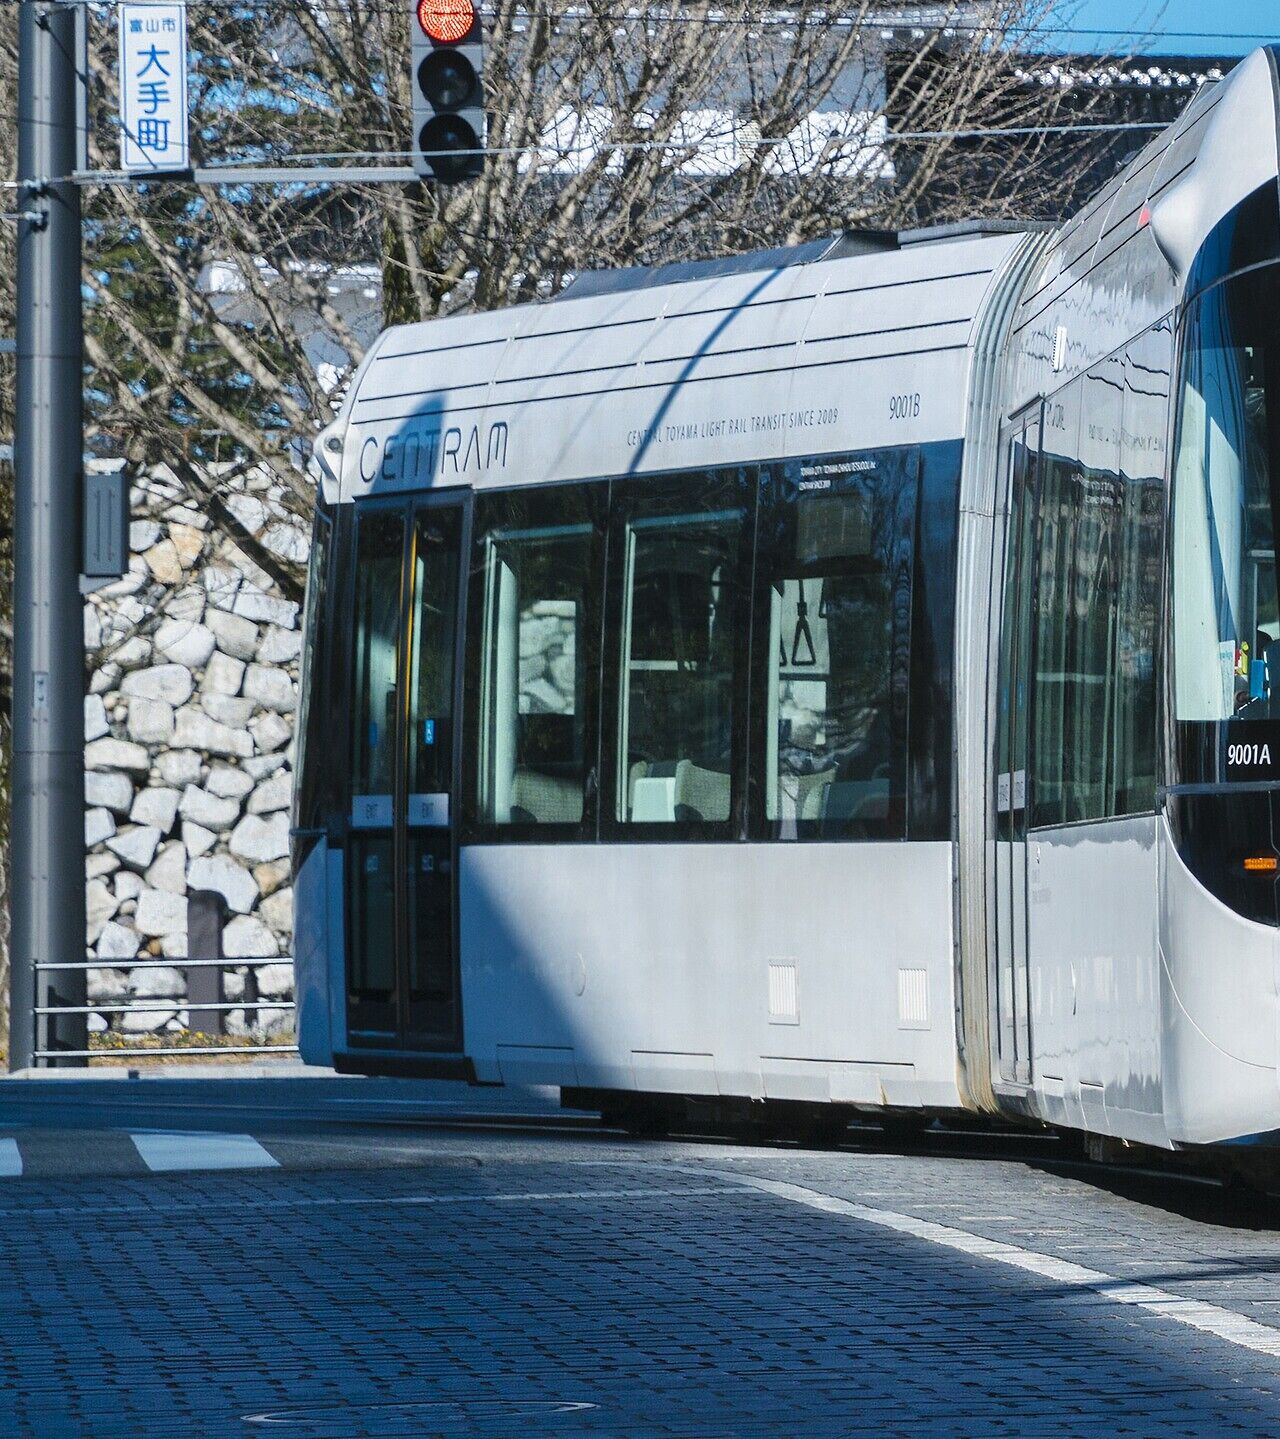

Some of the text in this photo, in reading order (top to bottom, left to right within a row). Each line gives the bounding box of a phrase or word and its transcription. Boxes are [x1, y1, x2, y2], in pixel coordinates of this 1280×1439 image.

[136, 44, 171, 152] 大手町
[889, 393, 921, 420] 9001B
[701, 420, 726, 438] LIGHT
[728, 418, 748, 435] RAIL
[751, 414, 786, 432] TRANSIT
[789, 410, 815, 428] SINCE
[817, 407, 839, 425] 2009
[359, 421, 508, 483] CENTRAM
[1227, 743, 1271, 765] 9001A
